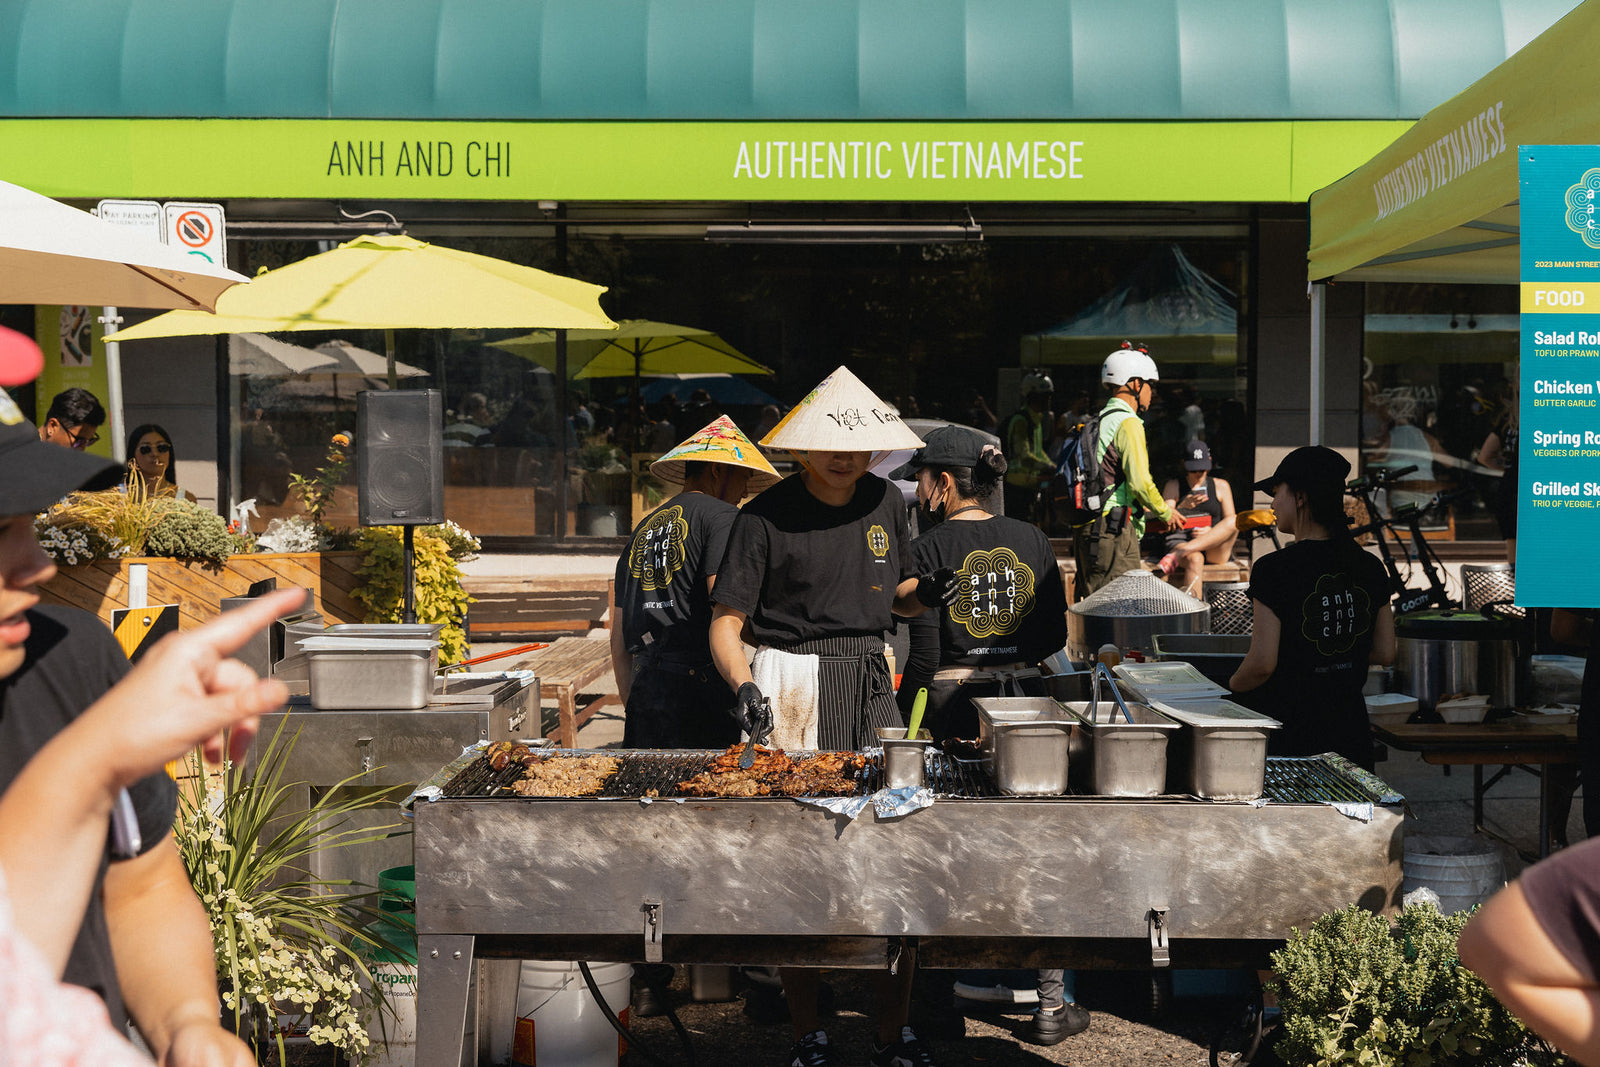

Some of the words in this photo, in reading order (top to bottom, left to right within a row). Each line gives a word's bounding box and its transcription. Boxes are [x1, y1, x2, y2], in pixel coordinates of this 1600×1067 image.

[327, 140, 385, 177] ANH
[396, 140, 454, 177] AND
[465, 140, 511, 178] CHI
[733, 141, 892, 179] AUTHENTIC
[901, 141, 1084, 179] VIETNAMESE
[1373, 152, 1430, 223] AUTHENTIC
[1425, 101, 1507, 191] VIETNAMESE
[1534, 260, 1553, 268] 2023
[1554, 260, 1575, 268] MAIN
[1534, 290, 1585, 306] FOOD
[1534, 331, 1575, 345] Salad
[1534, 349, 1556, 357] TOFU
[1557, 349, 1568, 357] OR
[1534, 379, 1593, 394] Chicken
[1533, 399, 1566, 407] BUTTER
[1567, 399, 1597, 408] GARLIC
[1533, 430, 1581, 448] Spring
[1533, 449, 1567, 457] VEGGIES
[1568, 449, 1580, 457] OR
[1532, 481, 1580, 496] Grilled
[1532, 499, 1551, 508] TRIO
[1552, 499, 1563, 508] OF
[1564, 500, 1595, 509] VEGGIE,
[970, 566, 1016, 586] anh
[971, 582, 1016, 602] and
[1321, 589, 1354, 607] anh
[971, 599, 1014, 618] chi
[1323, 604, 1355, 622] and
[1323, 619, 1354, 637] chi
